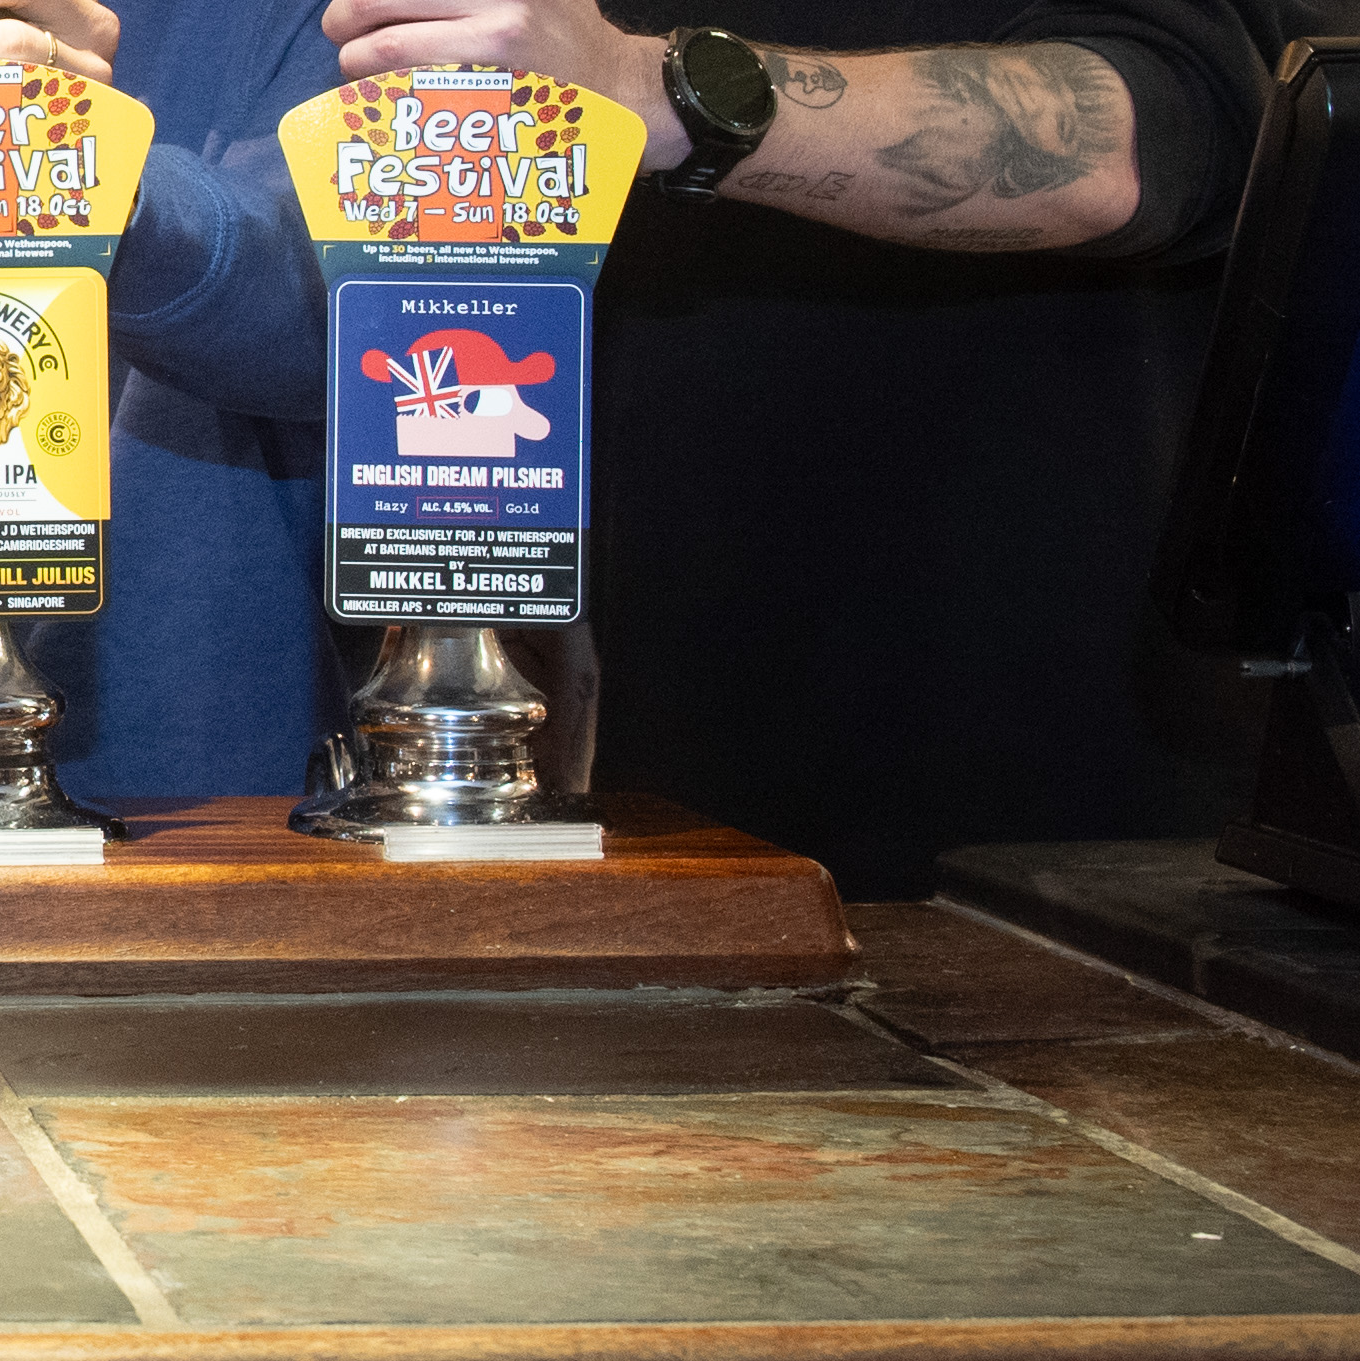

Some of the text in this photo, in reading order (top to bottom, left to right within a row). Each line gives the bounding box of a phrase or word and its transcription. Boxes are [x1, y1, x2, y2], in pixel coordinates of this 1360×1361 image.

[417, 76, 509, 88] wetherspoon
[390, 96, 536, 153] Beer
[337, 142, 588, 199] Festival
[343, 200, 580, 224] Wed 7 Sun 18 Oct
[362, 244, 558, 258] Up to 30 beers, all new to Wetherspoon,
[378, 254, 424, 263] including
[434, 254, 497, 263] international
[499, 255, 539, 264] brewers
[401, 299, 517, 314] Mikkeller
[5, 464, 37, 483] IPA
[352, 464, 563, 488] ENGLISH DREAM PILSNER
[374, 501, 408, 513] Hazy
[421, 502, 493, 512] ALC. 4.5% VOL.
[505, 503, 539, 513] Gold
[340, 527, 574, 543] BREWED EXCLUSIVELY FOR J D WETHERSPOON
[364, 543, 550, 558] AT BATEMANS BREWERY, WAINFLEET
[31, 566, 95, 584] JULIUS
[370, 571, 543, 592] MIKKEL BJERGSØ
[7, 596, 64, 608] SINGAPORE
[342, 600, 570, 615] MIKKELLER APS COPENHAGEN DENMARK
